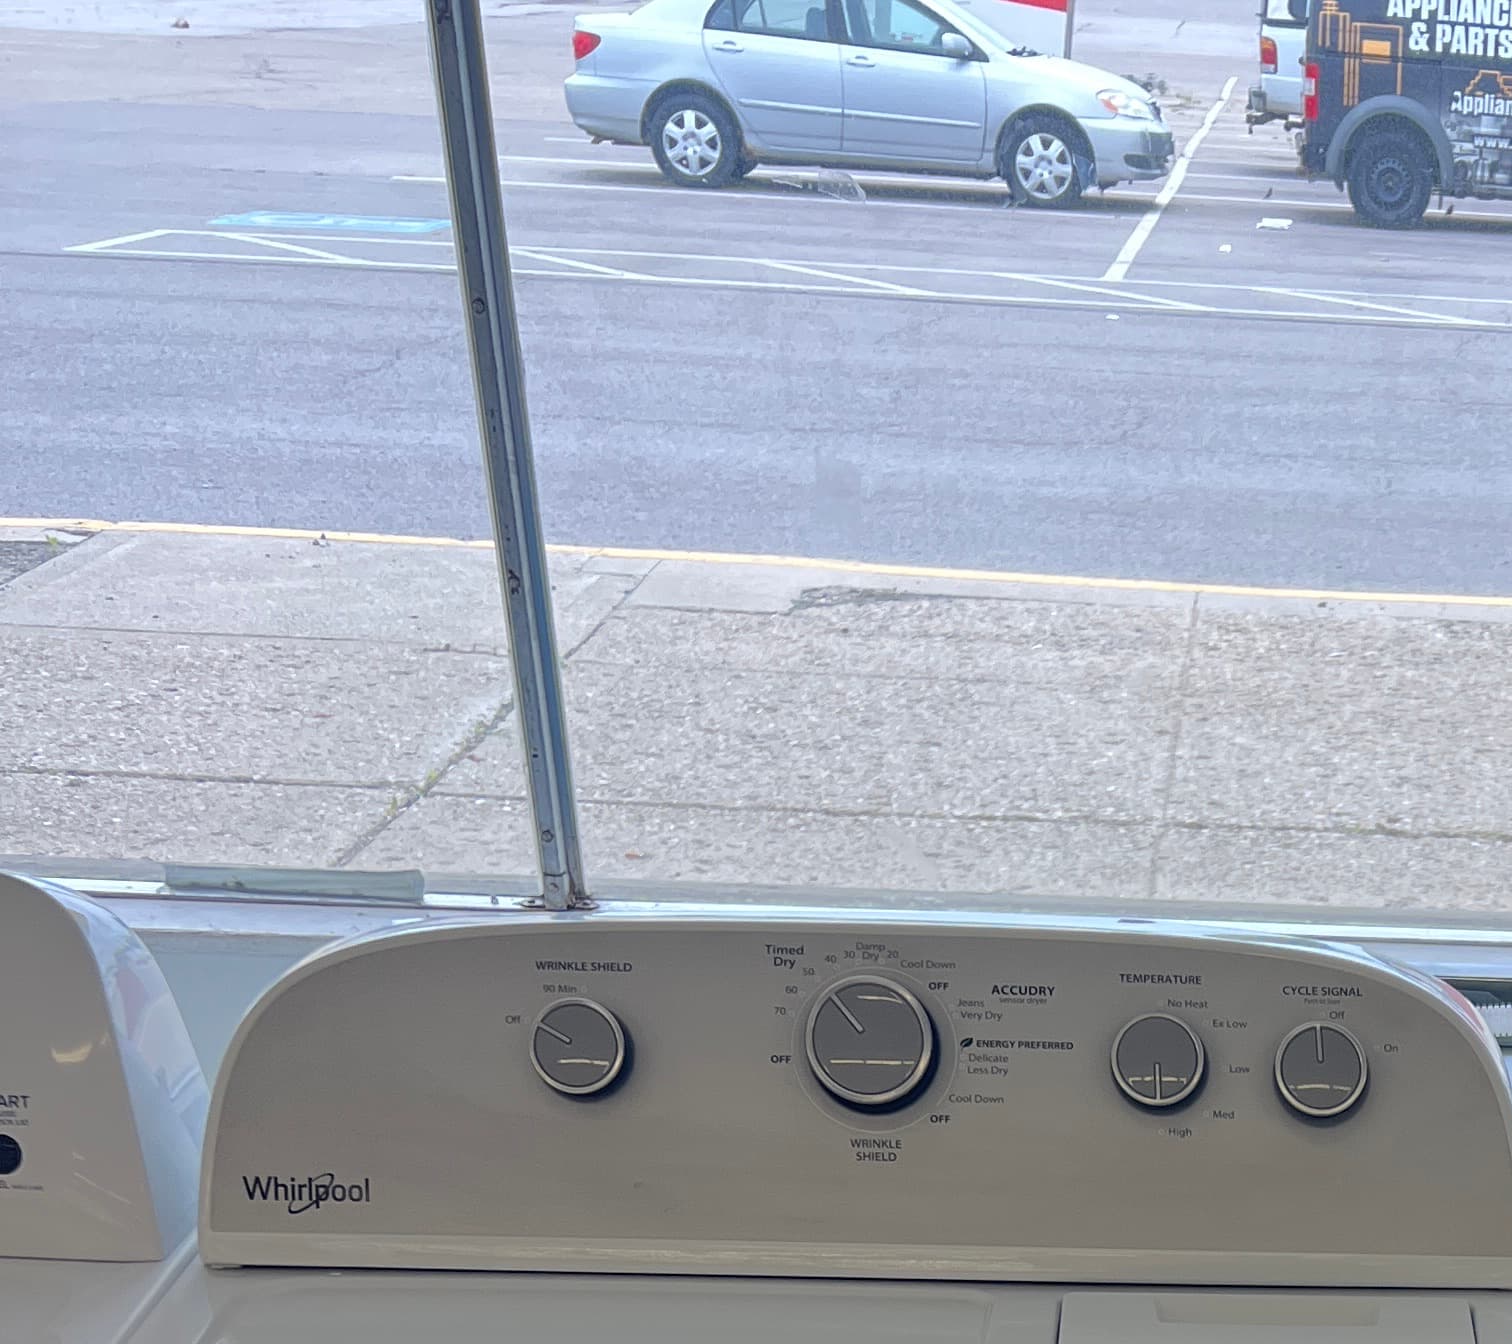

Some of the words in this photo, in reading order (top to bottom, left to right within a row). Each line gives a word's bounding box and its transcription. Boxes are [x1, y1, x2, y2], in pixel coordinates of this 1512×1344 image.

[1409, 22, 1429, 51] &
[765, 945, 804, 955] Timed
[856, 942, 886, 952] Damp
[824, 955, 837, 964] 40
[843, 951, 855, 959] 30
[862, 951, 879, 961] Dry
[887, 950, 899, 959] 20
[535, 961, 587, 972] WRINKLE
[591, 962, 632, 972] SHIELD
[773, 956, 796, 969] Dry
[900, 960, 924, 969] Cool
[926, 960, 956, 969] Down
[803, 968, 814, 976] 50
[1119, 973, 1202, 985] TEMPERATURE
[543, 984, 555, 993] 90
[558, 984, 577, 993] Min
[785, 985, 797, 994] 60
[928, 982, 949, 990] OFF
[991, 985, 1055, 996] ACCUDRY
[1282, 985, 1319, 996] CYCLE
[1321, 986, 1363, 997] SIGNAL
[1167, 999, 1183, 1008] No
[1184, 999, 1208, 1009] Heat
[774, 1006, 786, 1015] 70
[1329, 1011, 1345, 1019] Off
[505, 1015, 521, 1024] Off
[960, 1011, 982, 1021] Very
[985, 1011, 1003, 1022] Dry
[1226, 1019, 1248, 1028] Low
[976, 1040, 1015, 1049] ENERGY
[1018, 1040, 1074, 1050] PREFERRED
[1383, 1043, 1399, 1053] On
[770, 1054, 791, 1064] OFF
[968, 1053, 1009, 1063] Delicate
[967, 1066, 989, 1075] Less
[991, 1066, 1008, 1077] Dry
[1229, 1064, 1250, 1073] Low
[948, 1094, 972, 1103] Cool
[975, 1094, 1004, 1104] Down
[930, 1114, 950, 1123] OFF
[1212, 1110, 1235, 1120] Med
[1168, 1127, 1192, 1138] High
[850, 1138, 902, 1149] WRINKLE
[856, 1151, 897, 1162] SHIELD
[243, 1173, 370, 1213] Whirlpool
